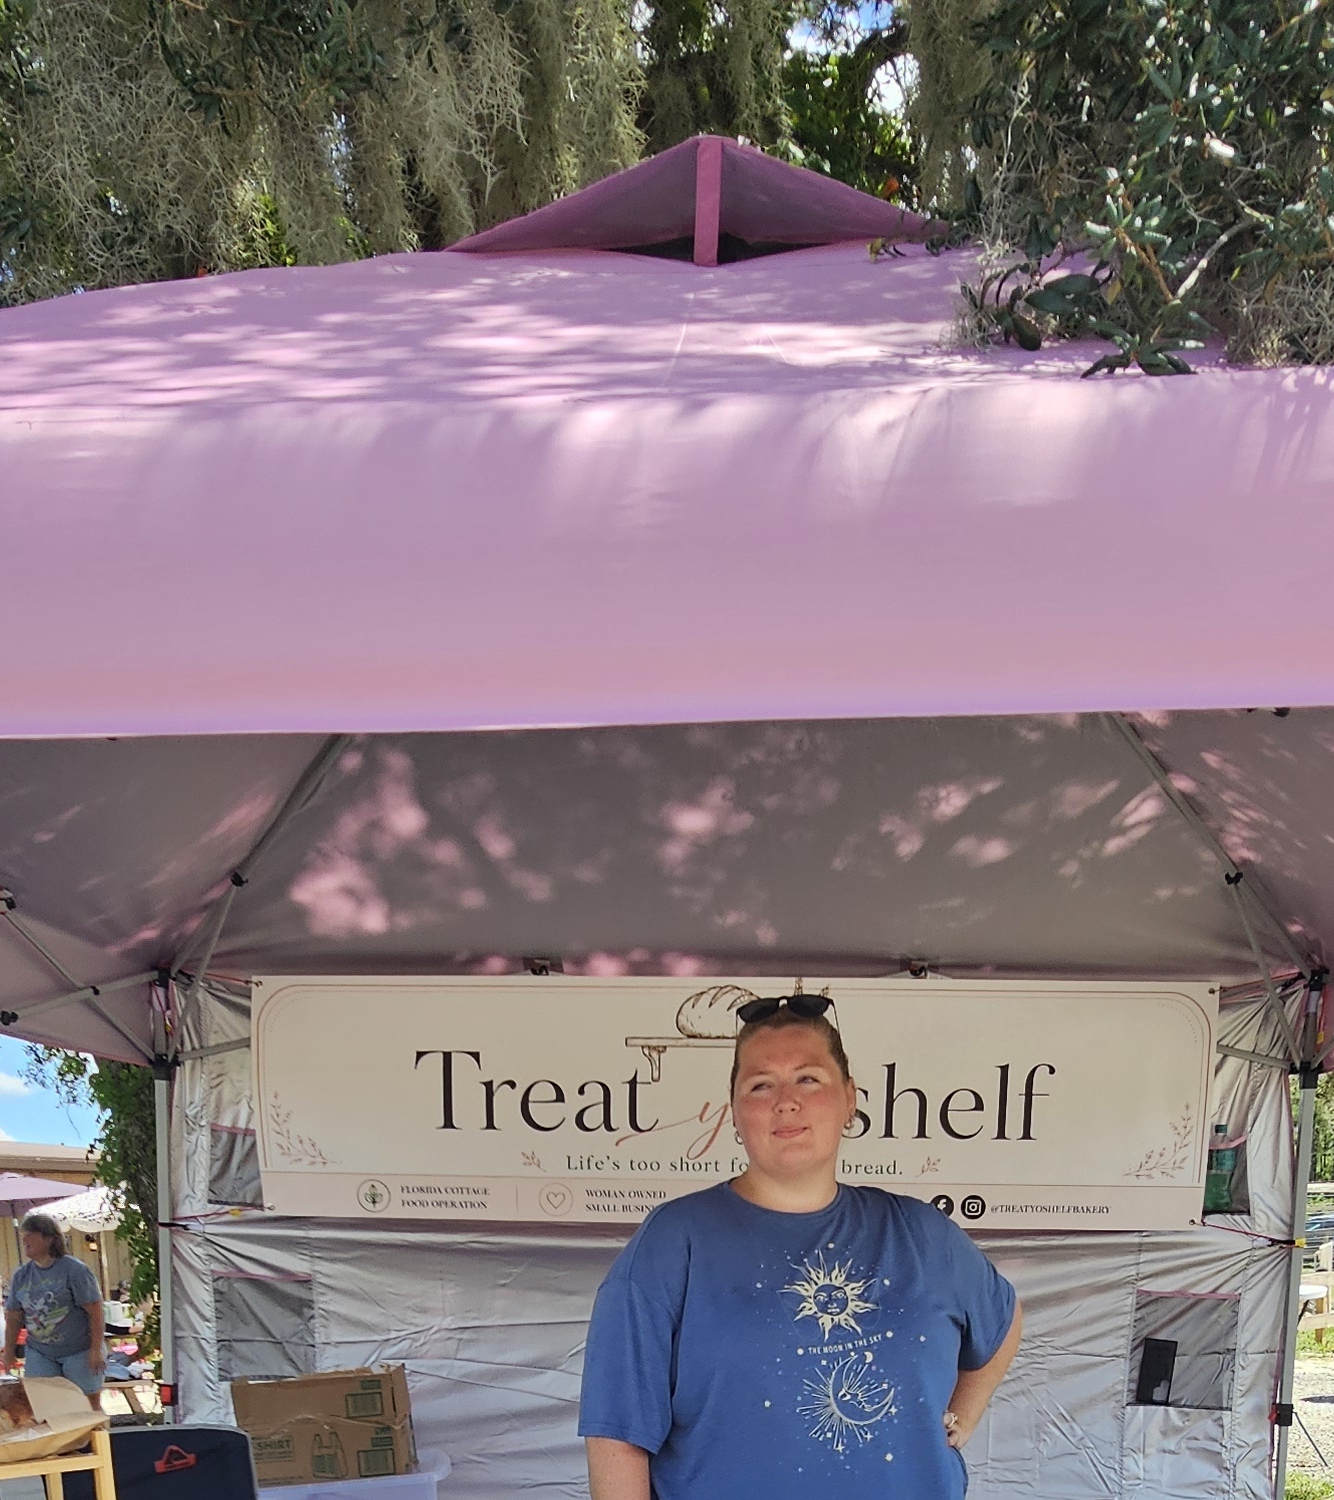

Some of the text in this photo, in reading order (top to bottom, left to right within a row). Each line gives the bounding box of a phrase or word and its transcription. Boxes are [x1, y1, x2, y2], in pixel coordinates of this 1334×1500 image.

[414, 1049, 659, 1133] Treat
[841, 1062, 1056, 1141] shelf
[566, 1155, 904, 1176] Life's too short fo bread.
[400, 1185, 491, 1197] FLORIDA COTTAGE
[585, 1189, 667, 1200] WOMAN OWNED
[400, 1199, 488, 1210] FOOD OPERATION
[585, 1203, 1111, 1215] SMALL BUSIN @TREATYOSHELFBAKERY
[808, 1346, 821, 1355] THE
[823, 1344, 844, 1354] MOON
[854, 1338, 868, 1347] THE
[869, 1334, 882, 1345] SKY
